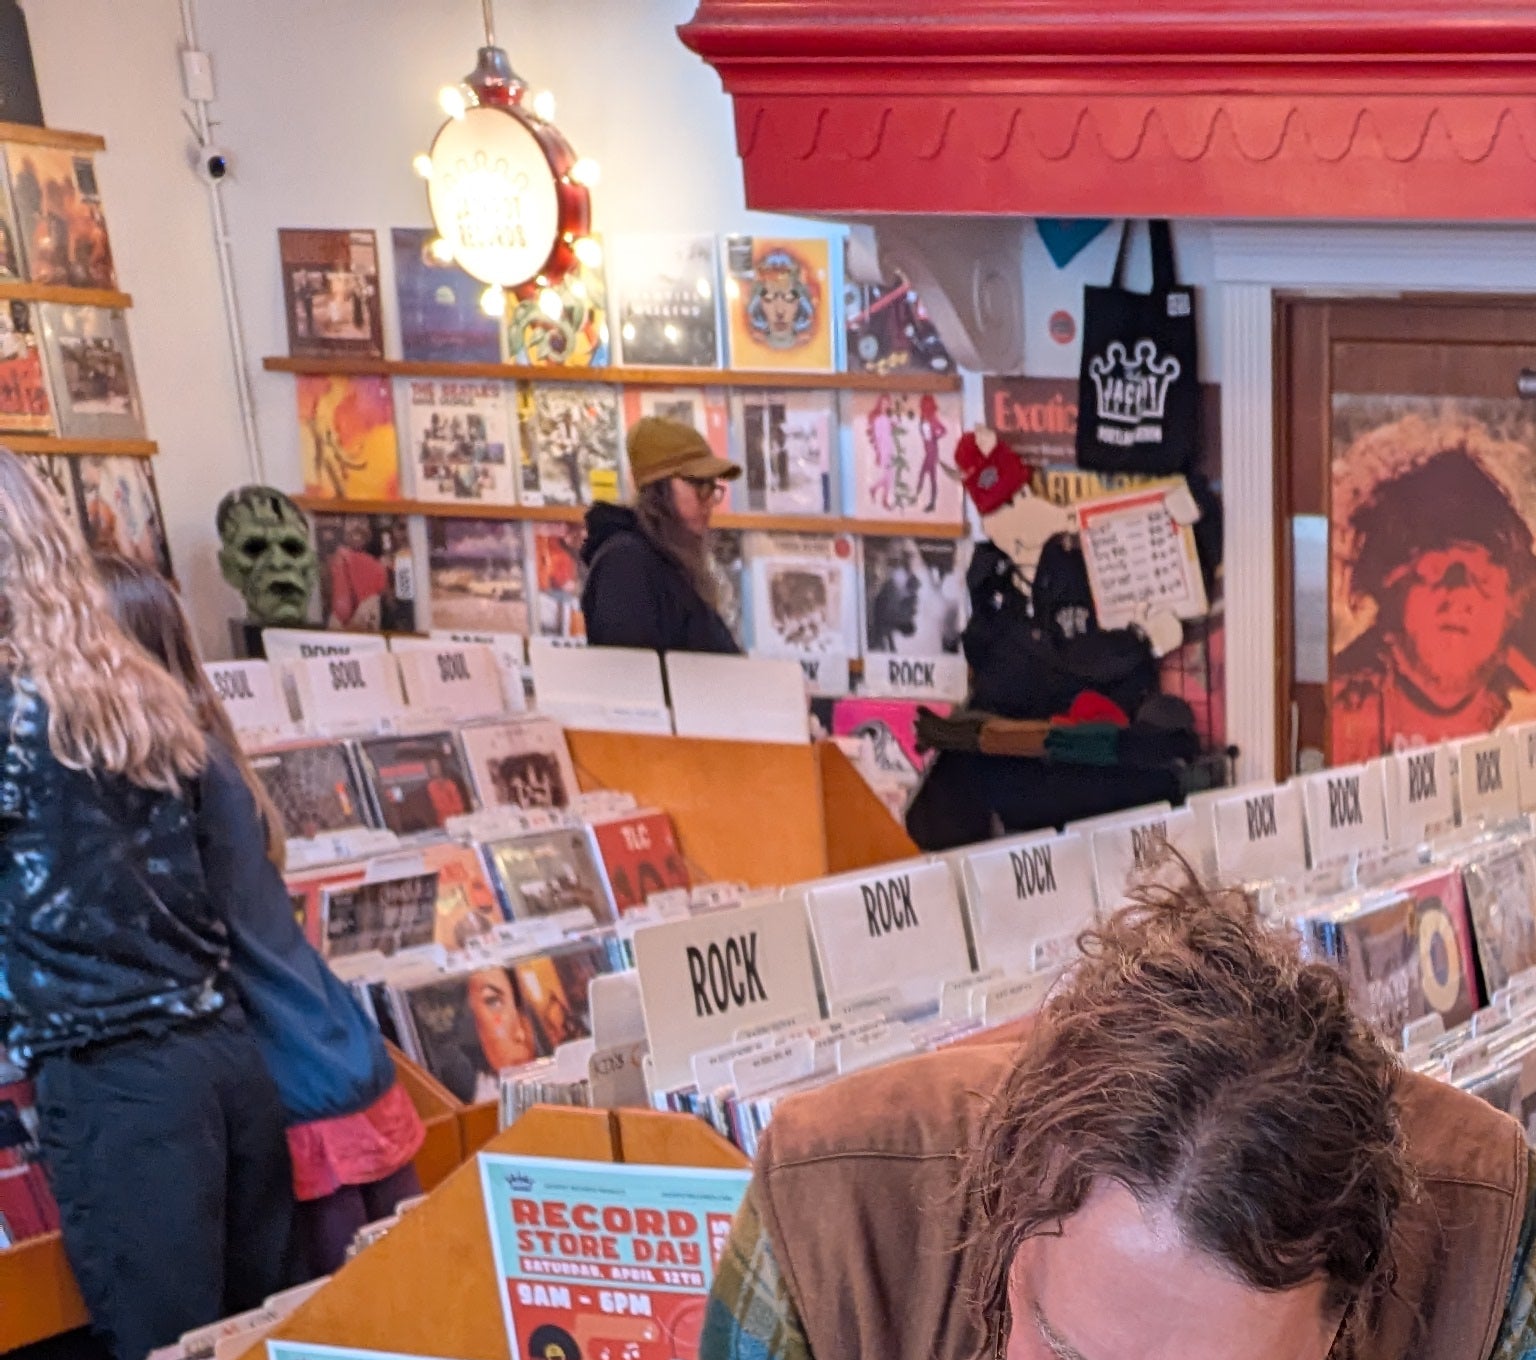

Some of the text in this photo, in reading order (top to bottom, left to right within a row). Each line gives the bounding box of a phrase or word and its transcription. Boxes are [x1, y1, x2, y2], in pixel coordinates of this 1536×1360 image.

[214, 670, 254, 700] SOUL
[329, 659, 366, 690] SOUL
[437, 652, 470, 683] SOUL
[888, 661, 935, 686] ROCK
[1408, 753, 1436, 803] ROCK
[1476, 749, 1503, 794] ROCK
[1245, 794, 1278, 842] ROCK
[1327, 776, 1363, 829] ROCK
[621, 824, 651, 851] TLC
[1008, 844, 1056, 901] ROCK
[859, 874, 920, 939] ROCK
[686, 931, 769, 1017] ROCK
[511, 1198, 698, 1239] RECORD
[516, 1229, 621, 1261] STORE
[632, 1238, 702, 1266] DAY
[611, 1266, 658, 1284] APRIL
[663, 1270, 703, 1287] 12TH
[516, 1284, 652, 1318] 9AM 6PM
